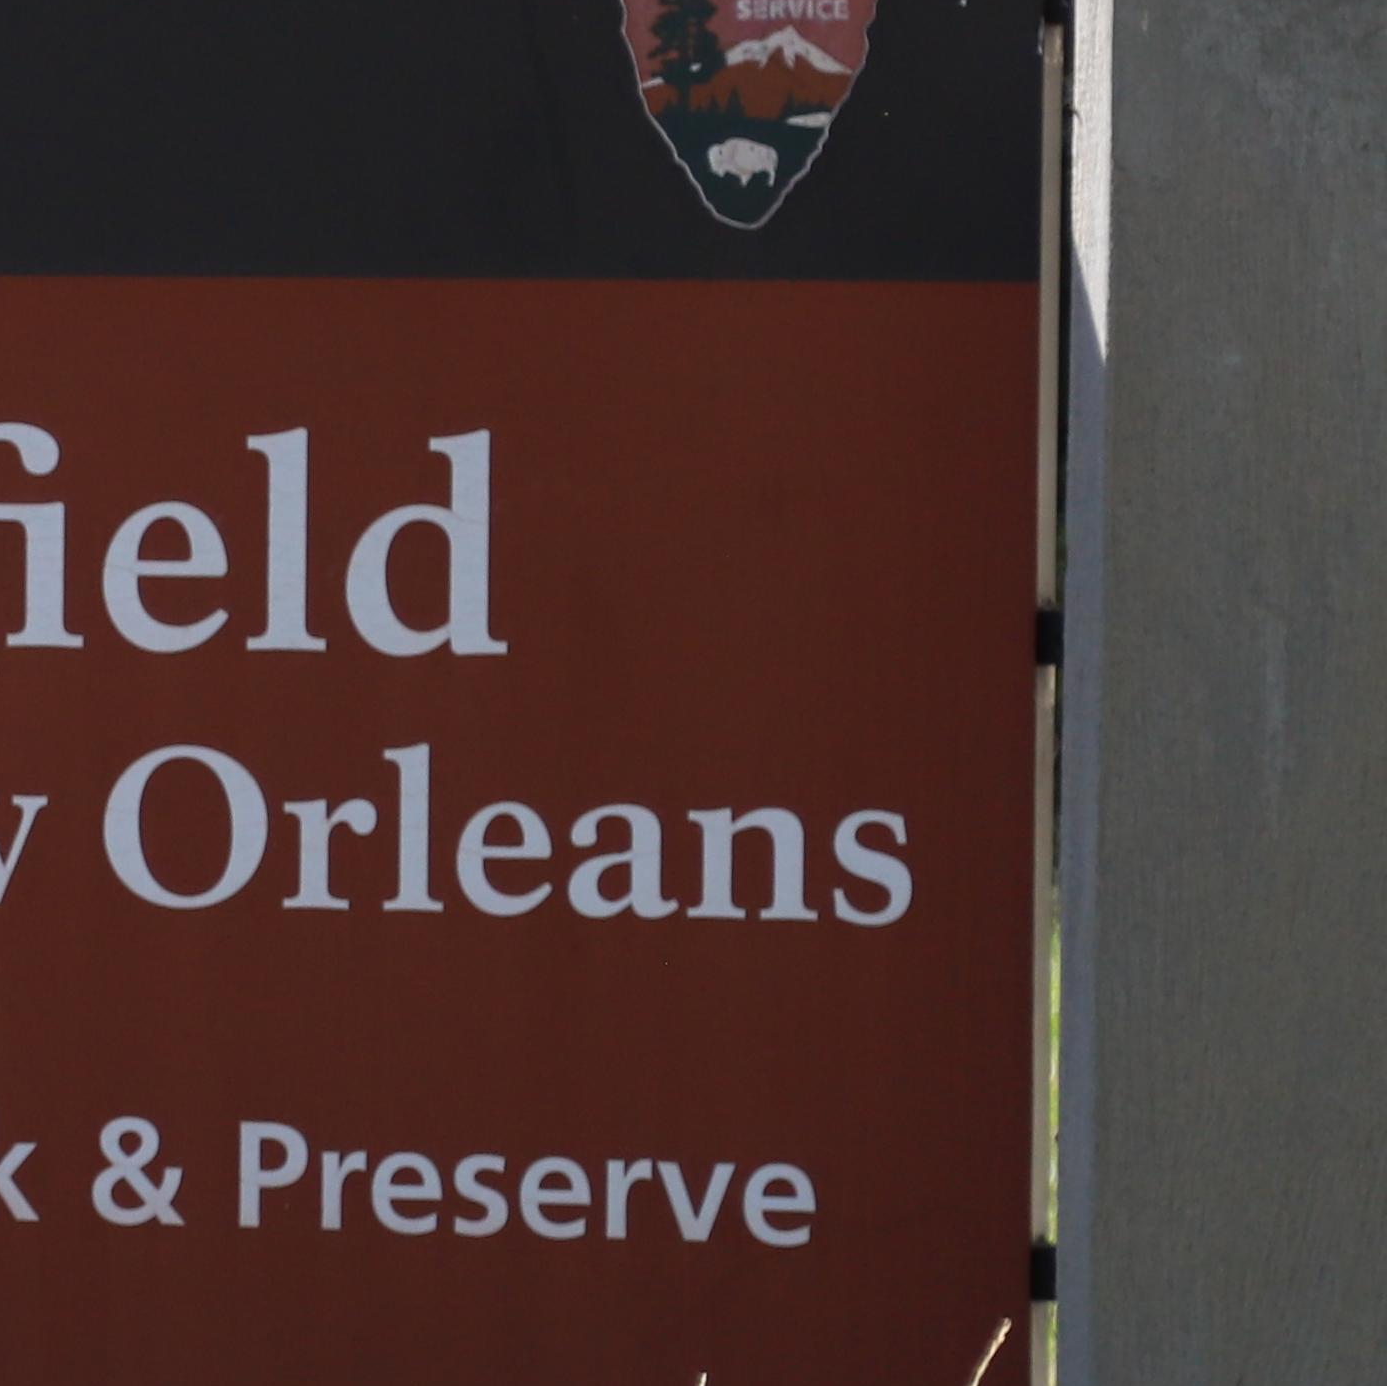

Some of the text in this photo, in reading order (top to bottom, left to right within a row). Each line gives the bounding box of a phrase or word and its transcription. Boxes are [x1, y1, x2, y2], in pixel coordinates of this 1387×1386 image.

[103, 743, 912, 926] Orleans
[92, 1116, 183, 1229] &
[239, 1121, 816, 1247] Preserve
